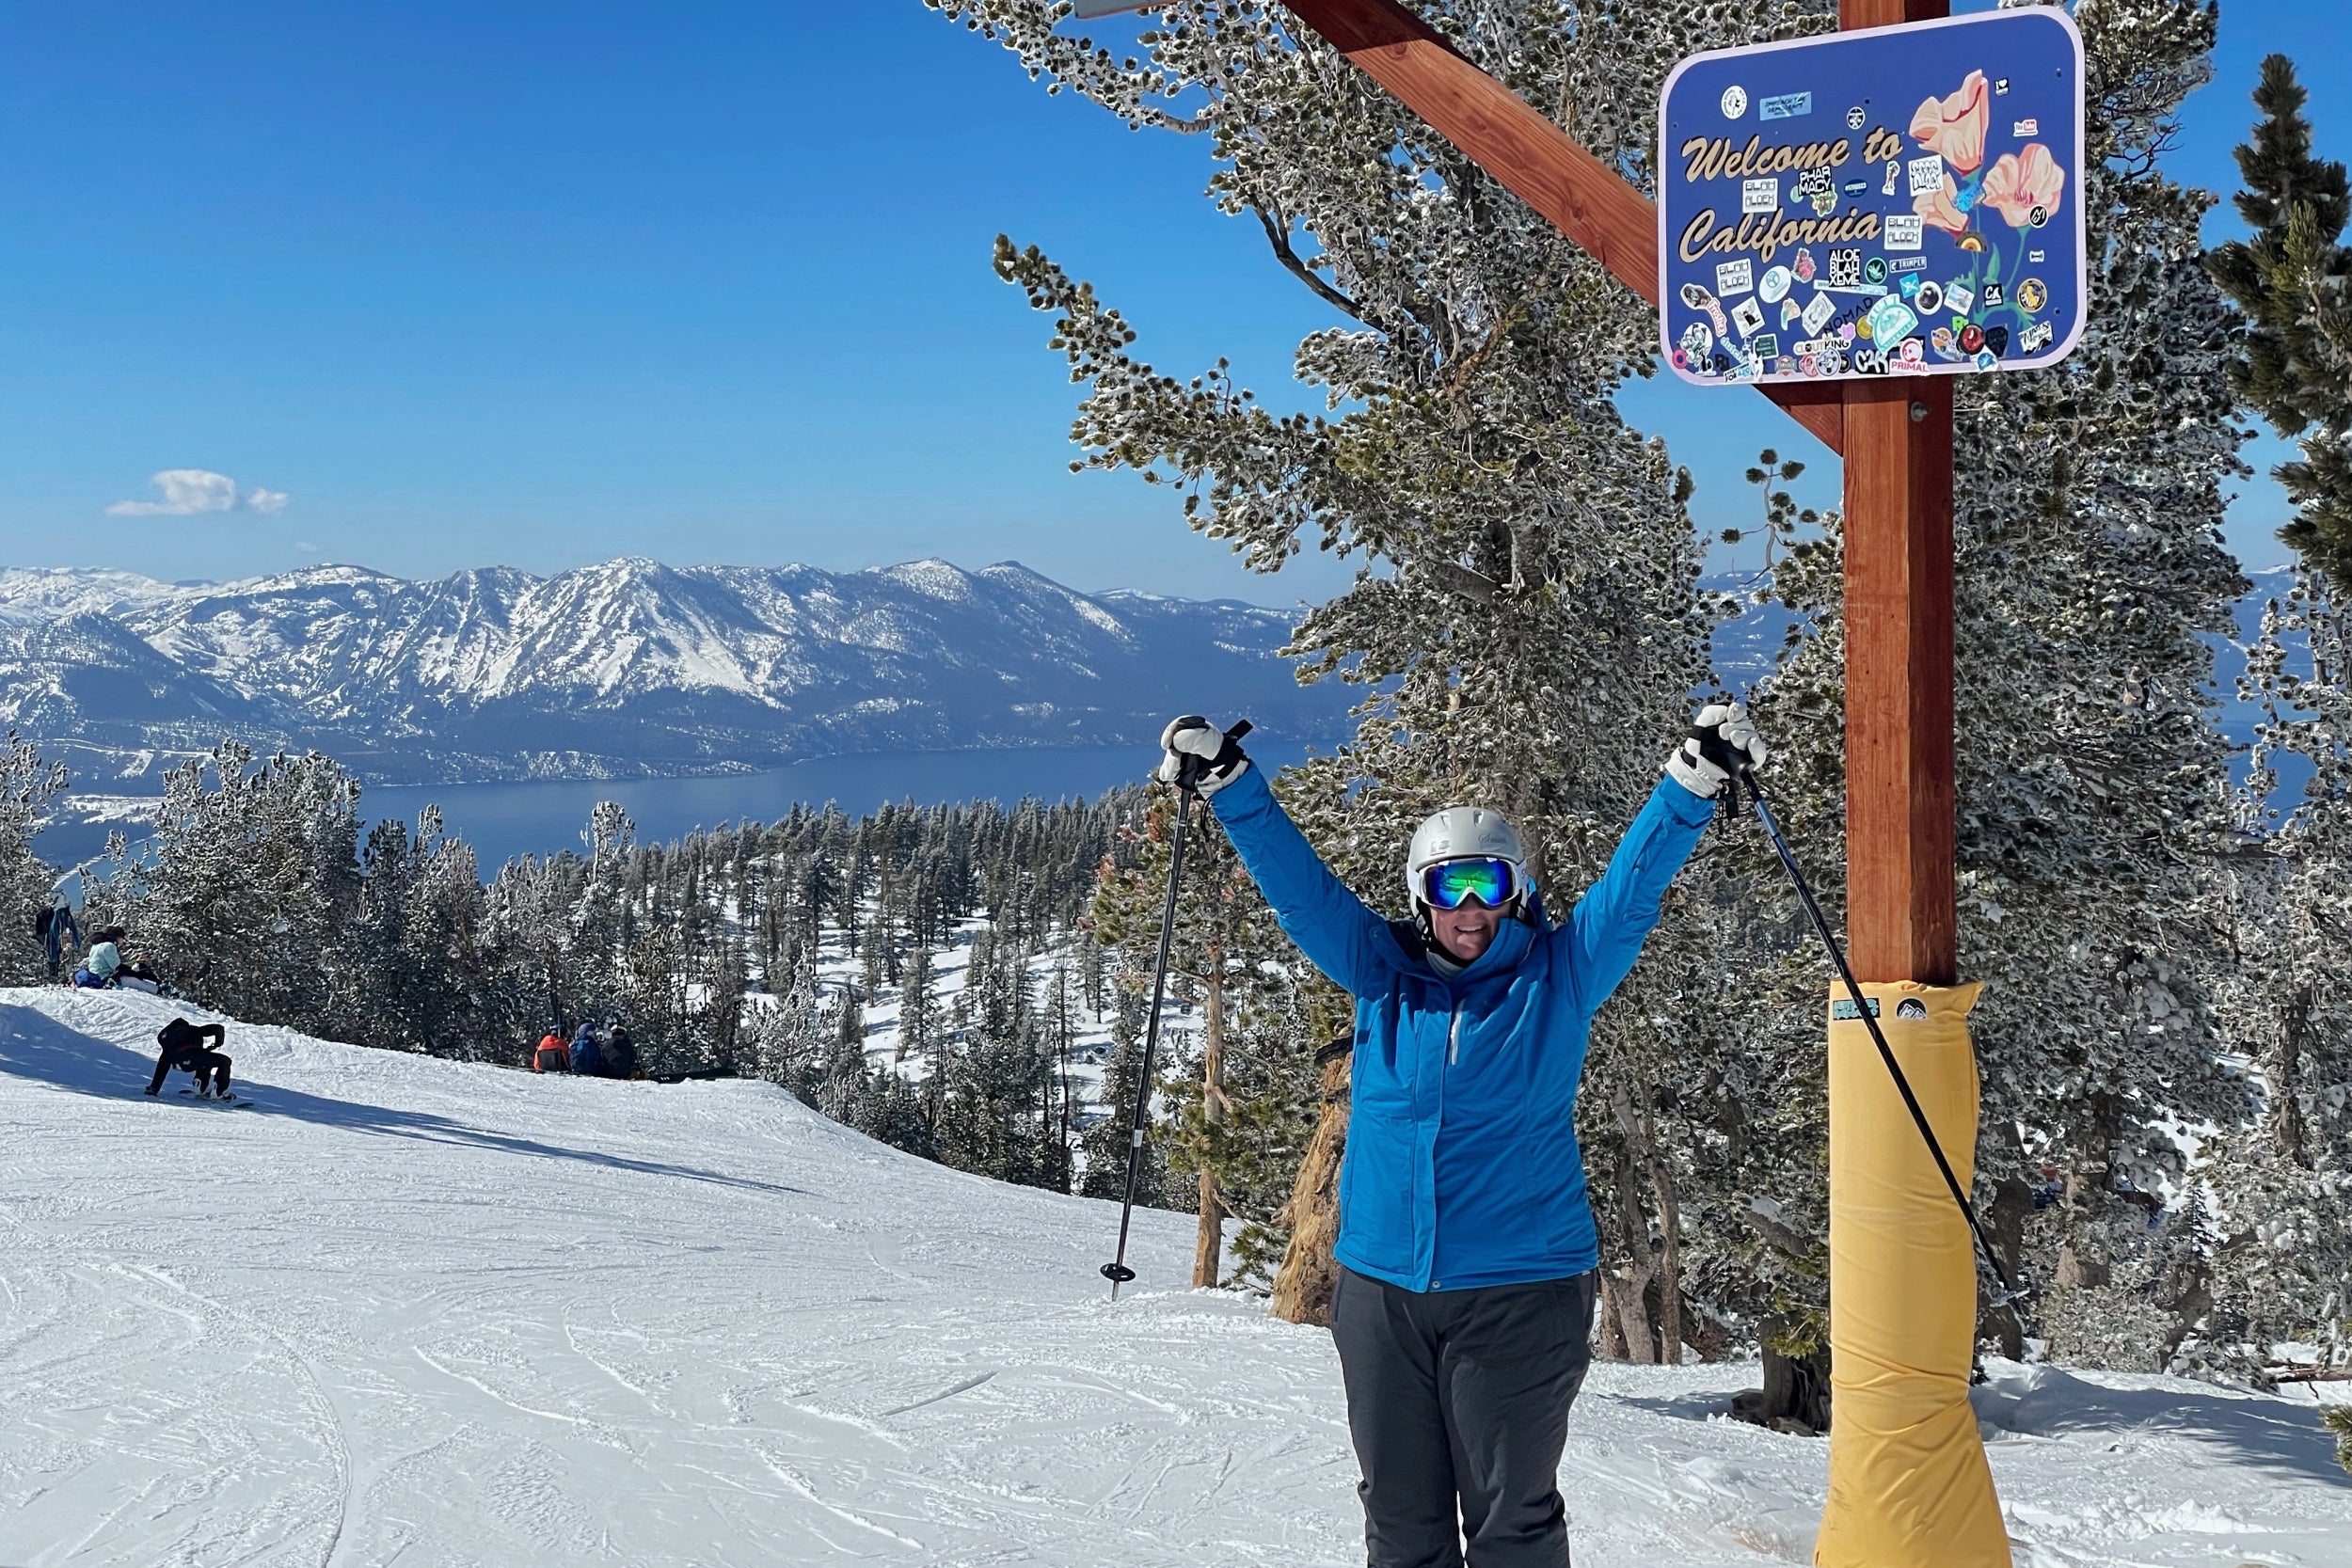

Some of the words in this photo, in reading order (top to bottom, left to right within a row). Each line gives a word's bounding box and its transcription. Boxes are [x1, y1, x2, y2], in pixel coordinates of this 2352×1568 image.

[1682, 134, 1850, 182] Welcome
[1863, 126, 1903, 164] to
[1799, 166, 1831, 184] PHAR
[1799, 178, 1831, 196] MACY
[1678, 206, 1882, 263] California
[1829, 249, 1860, 262] ALOE
[1829, 261, 1860, 275] BLAH
[1829, 273, 1860, 286] XEME
[1823, 297, 1873, 336] NOMAD
[1891, 361, 1930, 372] PRIMAL
